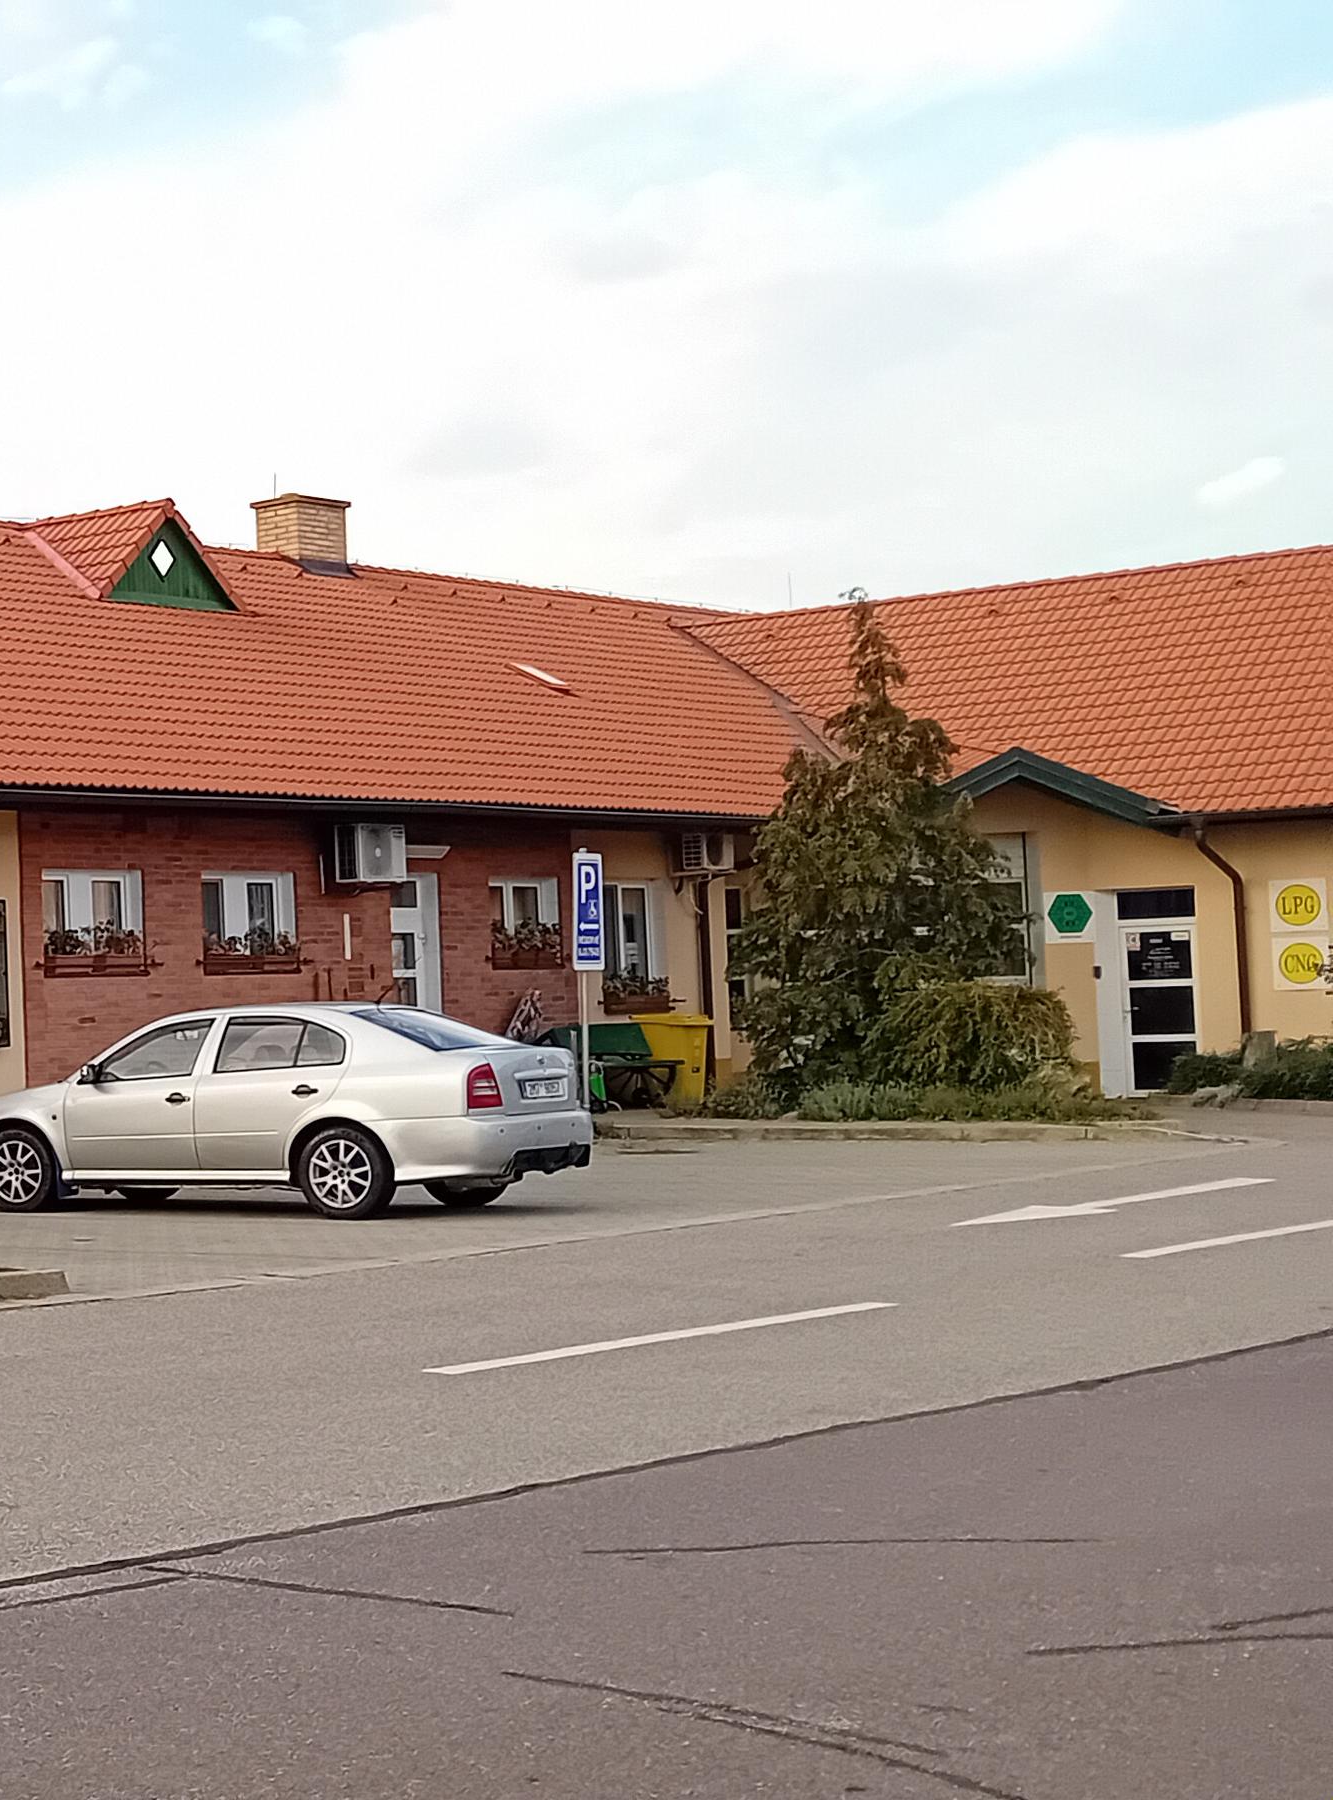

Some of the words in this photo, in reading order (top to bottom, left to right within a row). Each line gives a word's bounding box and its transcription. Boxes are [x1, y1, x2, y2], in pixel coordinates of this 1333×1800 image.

[580, 865, 596, 904] P
[1281, 895, 1315, 915] LPG
[1284, 953, 1318, 973] CNG
